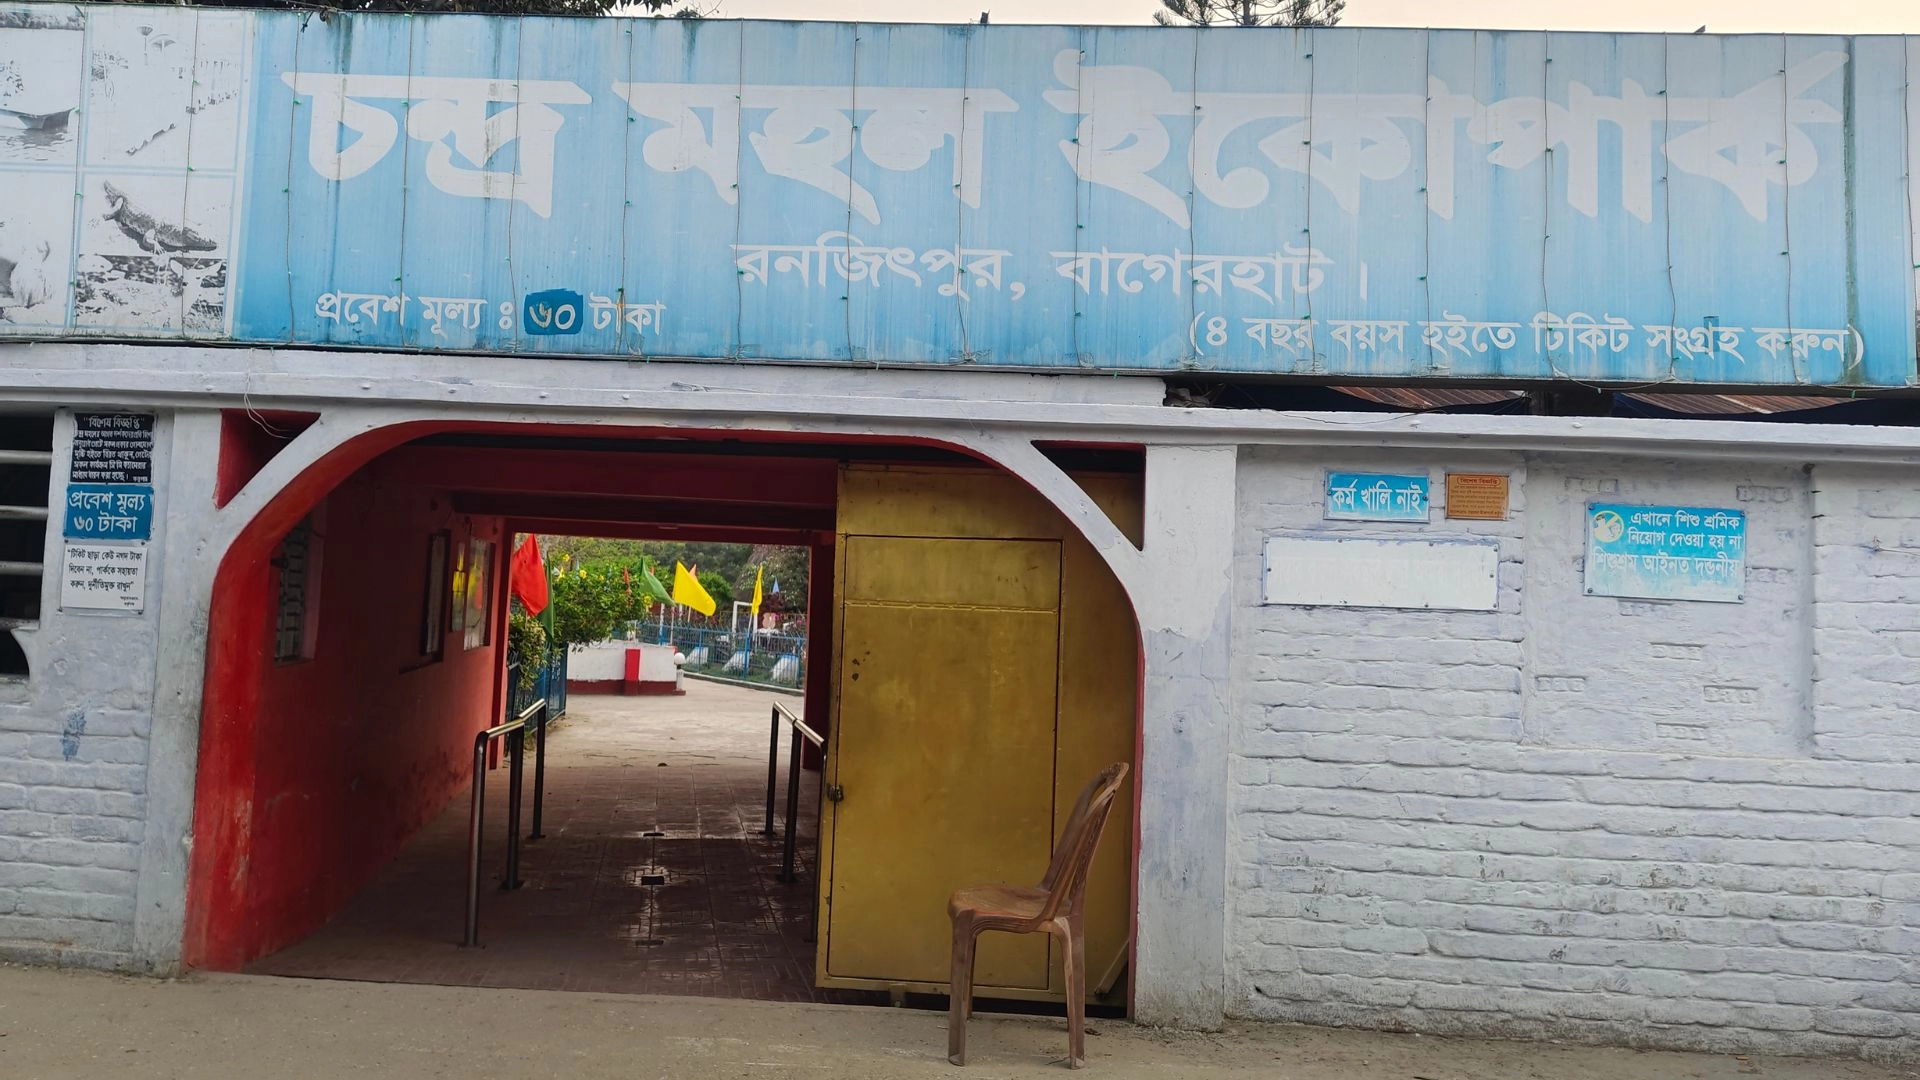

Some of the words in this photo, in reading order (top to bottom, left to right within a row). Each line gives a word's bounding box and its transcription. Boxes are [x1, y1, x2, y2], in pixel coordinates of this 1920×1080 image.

[281, 72, 592, 219] চন্দ্র
[611, 78, 1020, 225] মহল
[1042, 49, 1850, 230] ইকোপার্ক
[730, 231, 1025, 301] রনজিৎপুর,
[1049, 241, 1335, 305] বাগেরহাট
[316, 289, 411, 326] প্রবেশ
[418, 296, 488, 340] মূল্য
[529, 302, 576, 330] ৬০
[588, 292, 667, 336] টাকা
[1190, 311, 1227, 356] (৪
[1242, 317, 1319, 353] বছর
[1327, 320, 1410, 352] বয়স
[1417, 310, 1522, 357] হইতে
[1529, 311, 1634, 354] টিকিট
[1642, 322, 1745, 365] সংগ্রহ
[1752, 324, 1864, 371] করুন)
[69, 490, 114, 510] প্রবেশ
[117, 493, 146, 516] মূল্য
[1331, 478, 1357, 511] কর্ম
[1360, 480, 1391, 512] খালি
[1395, 481, 1424, 515] নাই
[98, 510, 139, 533] টাকা
[1631, 511, 1671, 528] এখানে
[1675, 510, 1700, 528] শিশু
[1704, 511, 1740, 531] শ্রমিক
[1628, 527, 1666, 547] নিয়োগ
[1670, 532, 1704, 548] দেওয়া
[1709, 534, 1725, 551] হয়
[1729, 534, 1742, 551] না
[1642, 549, 1691, 577] আইনত
